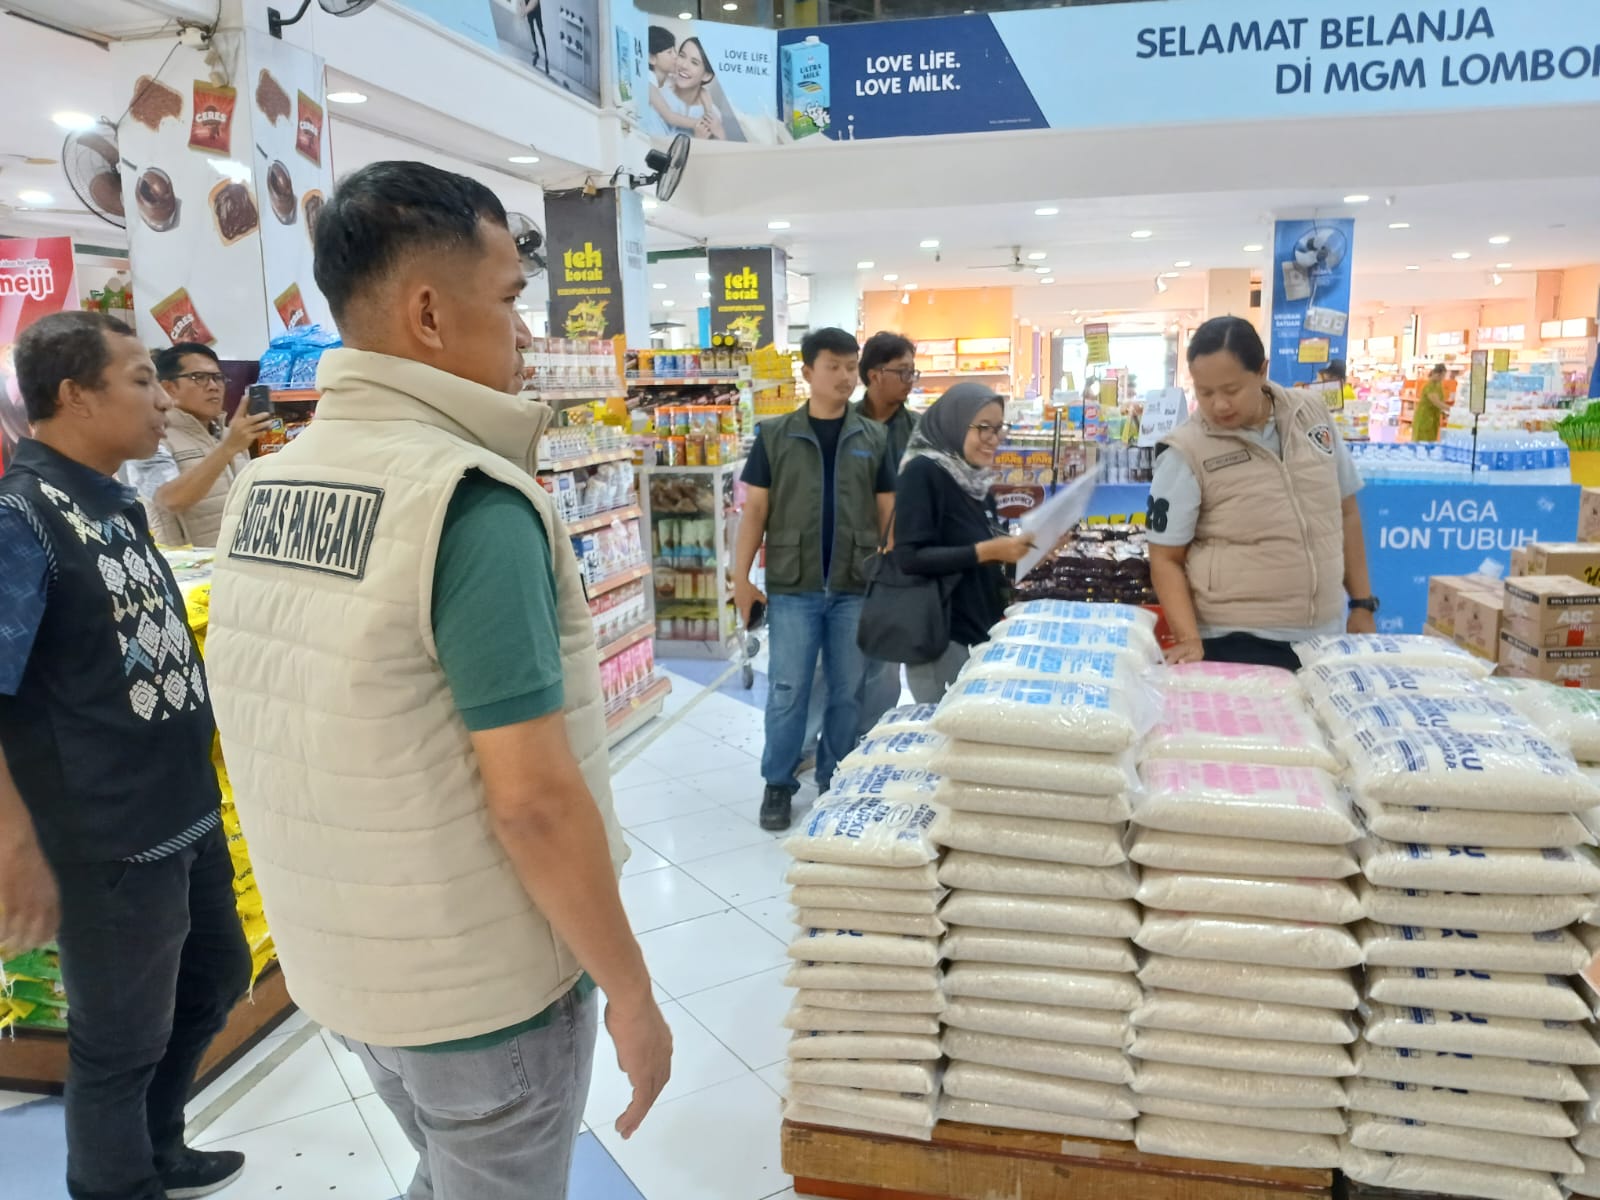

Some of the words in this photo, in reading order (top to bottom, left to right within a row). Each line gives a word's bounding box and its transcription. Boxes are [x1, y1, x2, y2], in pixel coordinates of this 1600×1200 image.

[1136, 17, 1309, 59] SELAMAT
[1320, 6, 1495, 50] BELANJA
[724, 49, 748, 61] LOVE
[866, 54, 913, 74] LOVE
[718, 62, 743, 74] LOVE
[1323, 57, 1427, 95] MGM
[855, 77, 902, 97] LOVE
[195, 111, 228, 123] CERES
[563, 242, 603, 269] teh
[564, 267, 603, 282] kotak
[724, 266, 759, 289] teh
[1421, 499, 1499, 523] JAGA
[234, 487, 291, 557] SATGAS
[283, 489, 372, 571] PANGAN
[1379, 526, 1431, 550] ION
[1437, 527, 1538, 551] TUBUH
[1556, 610, 1594, 625] ABC
[1554, 663, 1592, 679] ABC
